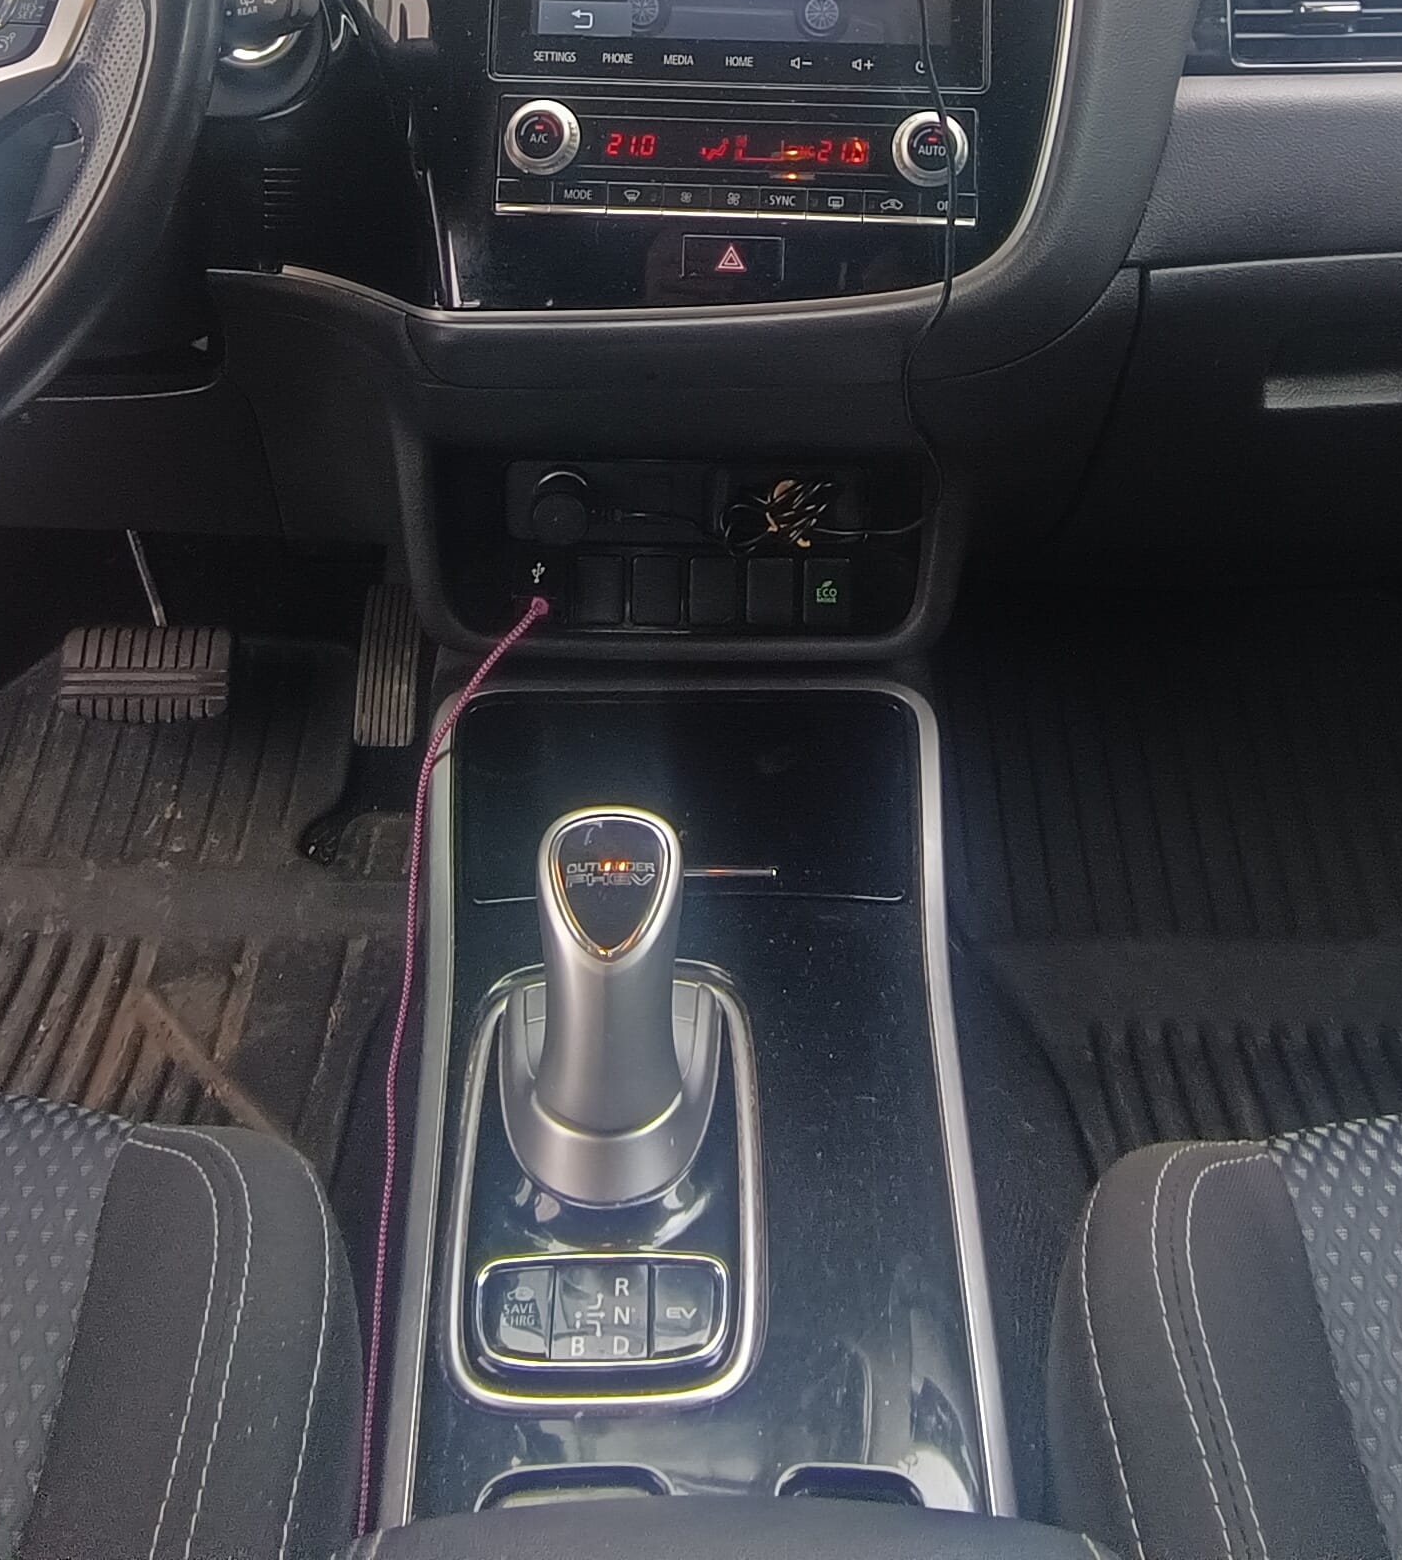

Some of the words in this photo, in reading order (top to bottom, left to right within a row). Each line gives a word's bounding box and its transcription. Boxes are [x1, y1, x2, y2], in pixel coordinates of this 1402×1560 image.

[237, 5, 258, 16] REAR
[533, 50, 577, 63] SETTINGS
[602, 52, 634, 65] PHONE
[663, 54, 695, 66] MEDIA
[725, 56, 755, 68] HOME
[529, 133, 549, 145] A/C
[917, 144, 947, 157] AUTO
[564, 189, 593, 201] MODE
[769, 195, 797, 207] SYNC
[816, 588, 838, 598] ECO
[565, 872, 656, 889] PHEV
[614, 1276, 630, 1297] R
[614, 1306, 630, 1325] N
[665, 1306, 698, 1320] EV
[502, 1314, 536, 1327] CHRG
[571, 1336, 585, 1356] B
[613, 1335, 630, 1356] D
